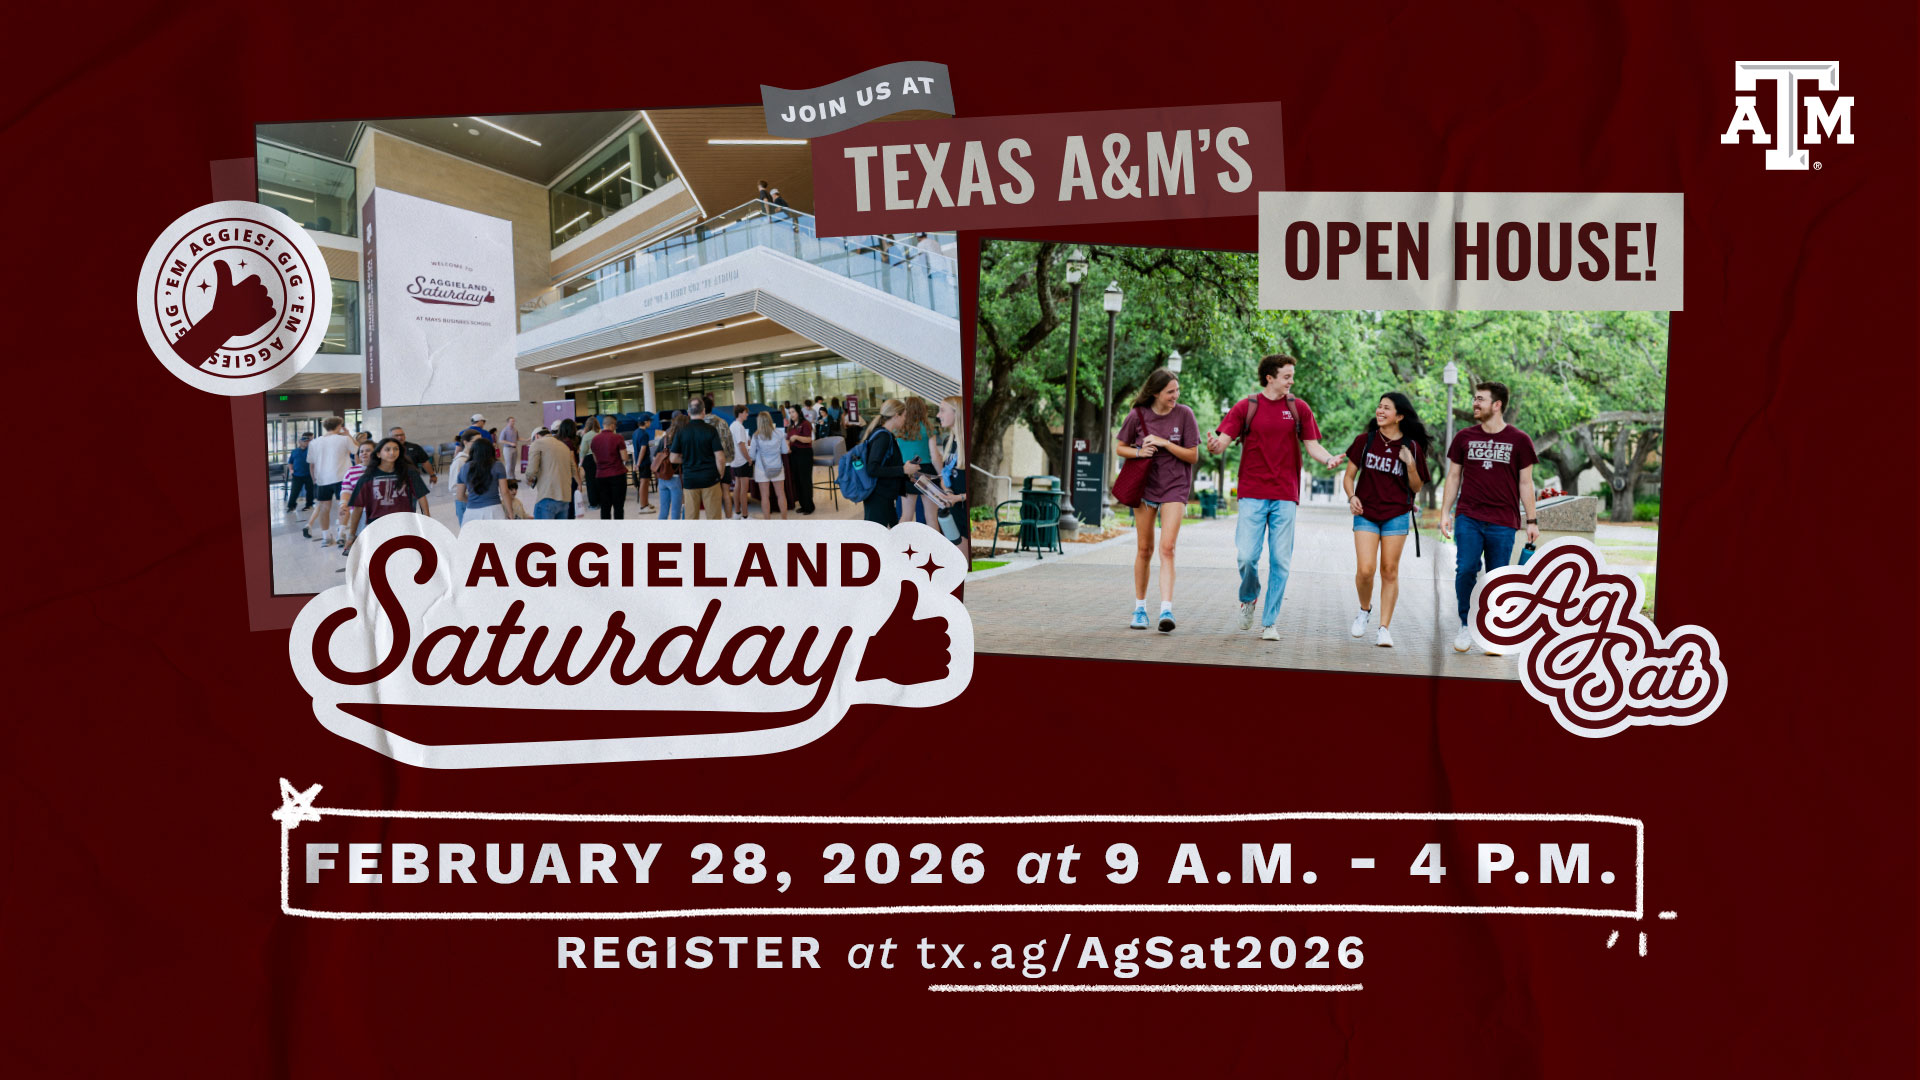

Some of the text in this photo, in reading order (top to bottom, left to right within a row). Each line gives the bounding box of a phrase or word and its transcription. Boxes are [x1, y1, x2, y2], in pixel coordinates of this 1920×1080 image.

[407, 275, 484, 306] Saturday
[430, 278, 488, 292] AGGIELAND
[1468, 441, 1493, 449] TEXAS
[1467, 448, 1511, 461] AGGIES
[1365, 452, 1392, 472] TEXAS
